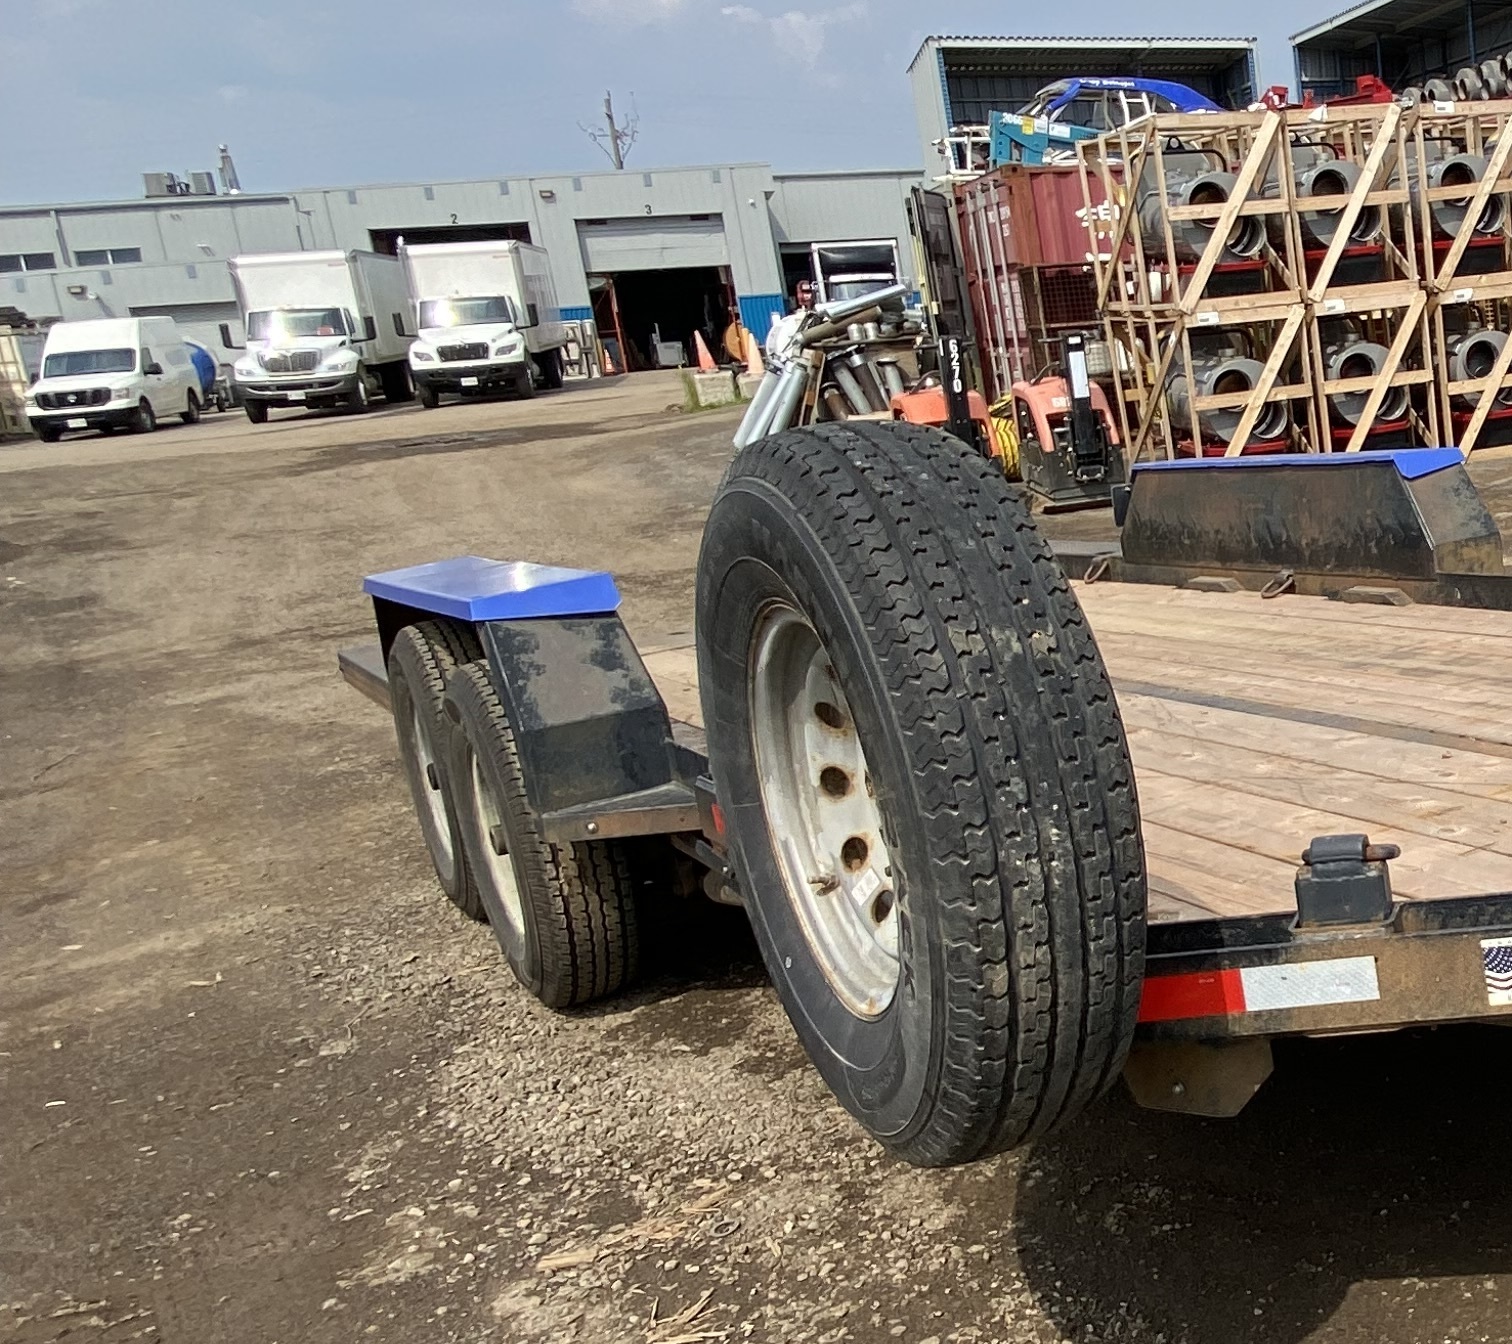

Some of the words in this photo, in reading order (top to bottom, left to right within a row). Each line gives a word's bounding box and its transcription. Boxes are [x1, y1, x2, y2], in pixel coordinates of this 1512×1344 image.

[645, 204, 652, 214] 3
[450, 213, 459, 224] 2
[949, 339, 962, 393] 6270
